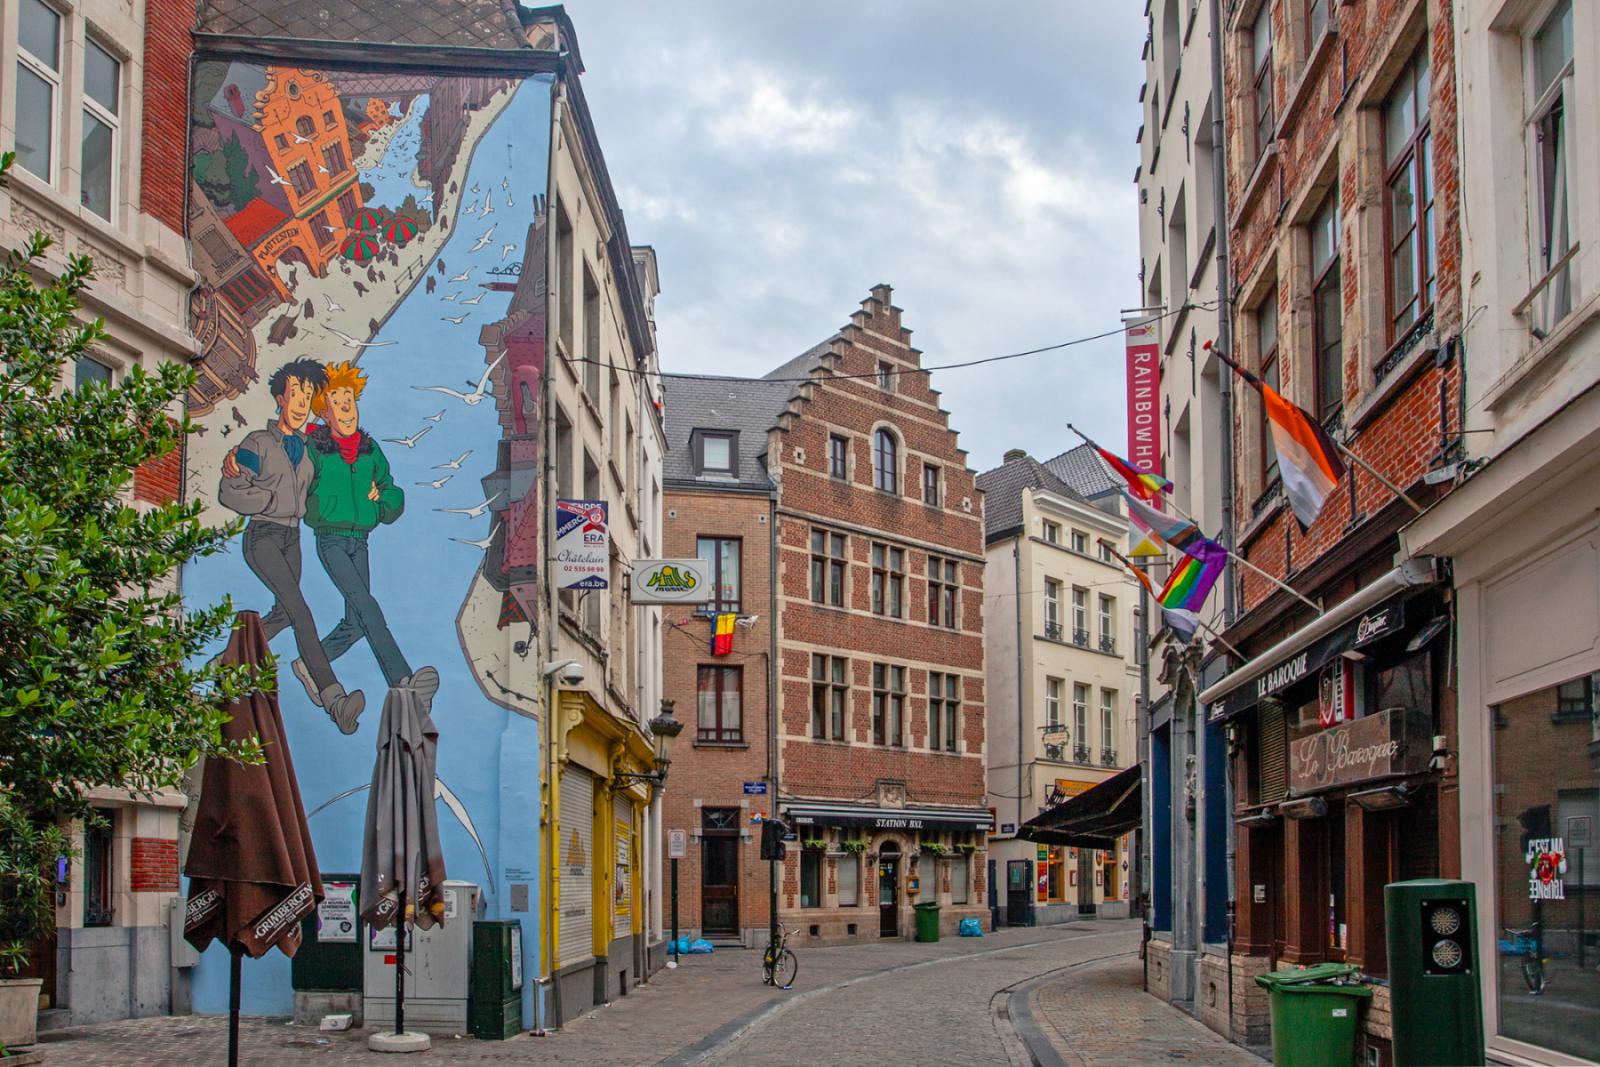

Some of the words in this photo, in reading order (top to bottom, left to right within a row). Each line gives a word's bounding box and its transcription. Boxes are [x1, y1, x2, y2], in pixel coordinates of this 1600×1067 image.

[1134, 352, 1153, 507] RAINBOWHO
[584, 533, 604, 542] ERA
[1257, 676, 1266, 697] LE
[1268, 652, 1307, 692] BAROQUE
[876, 818, 907, 828] STATION
[256, 883, 313, 937] GRIMBERGEN
